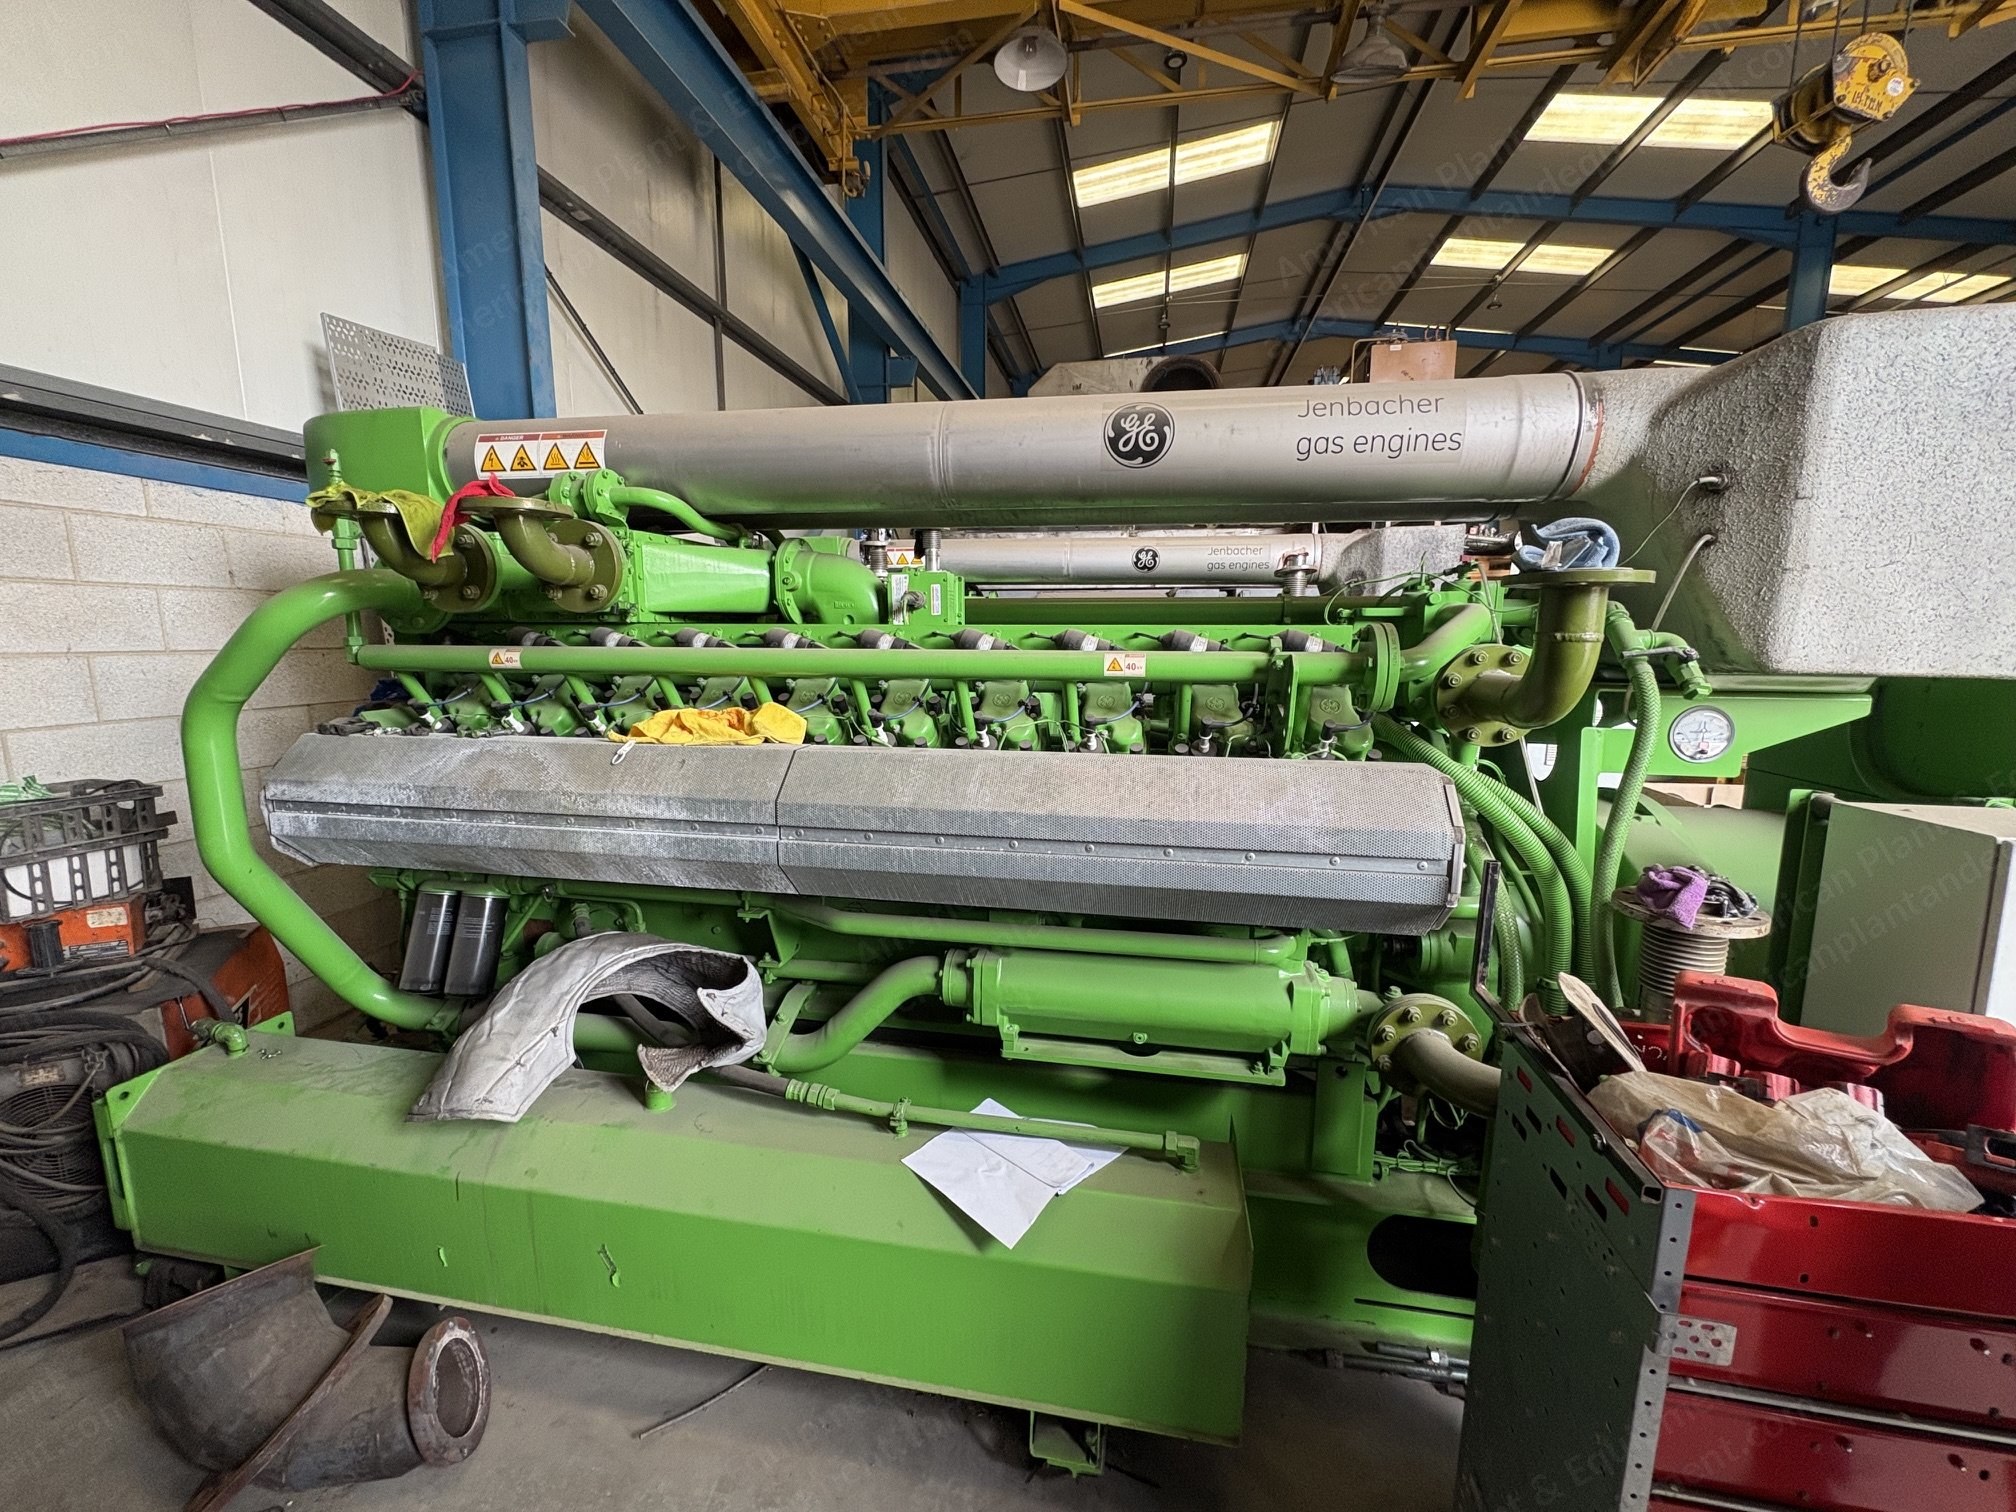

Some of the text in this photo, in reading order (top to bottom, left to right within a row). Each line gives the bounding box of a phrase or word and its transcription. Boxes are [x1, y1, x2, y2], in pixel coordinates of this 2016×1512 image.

[1298, 394, 1444, 418] Jenbacher
[1296, 427, 1462, 461] gas engines
[1207, 546, 1263, 556] Jenbacher
[1207, 559, 1270, 572] gas engines
[505, 656, 514, 664] 40
[1125, 662, 1137, 671] 40
